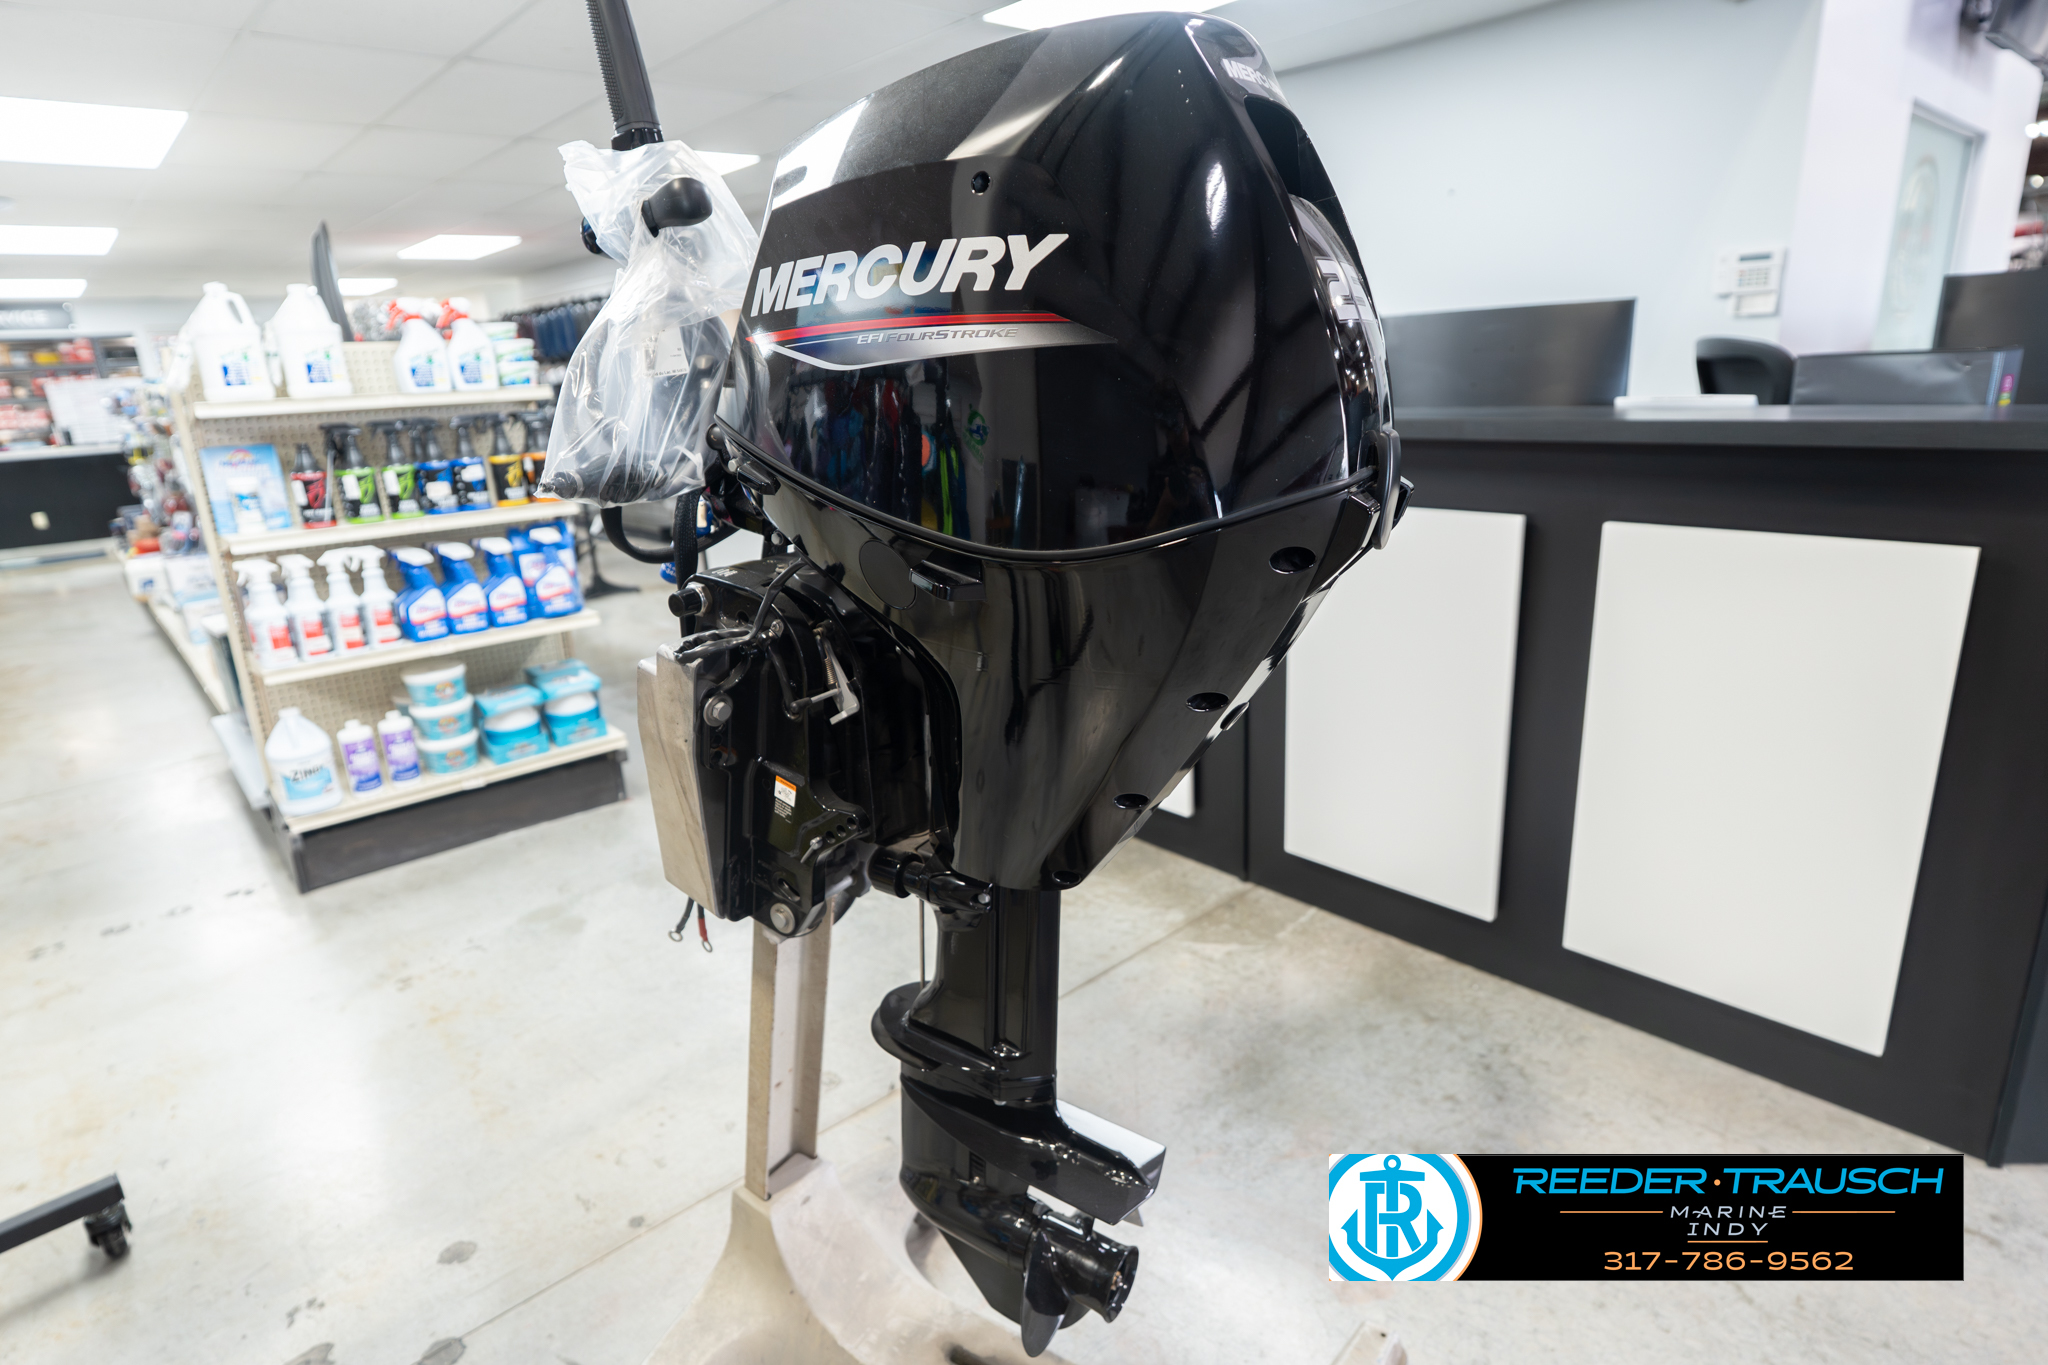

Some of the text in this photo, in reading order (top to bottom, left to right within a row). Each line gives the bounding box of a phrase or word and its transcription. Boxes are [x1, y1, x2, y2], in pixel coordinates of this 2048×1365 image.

[749, 233, 1069, 317] MERCURY
[856, 327, 1019, 345] EFI FOURSTROKE
